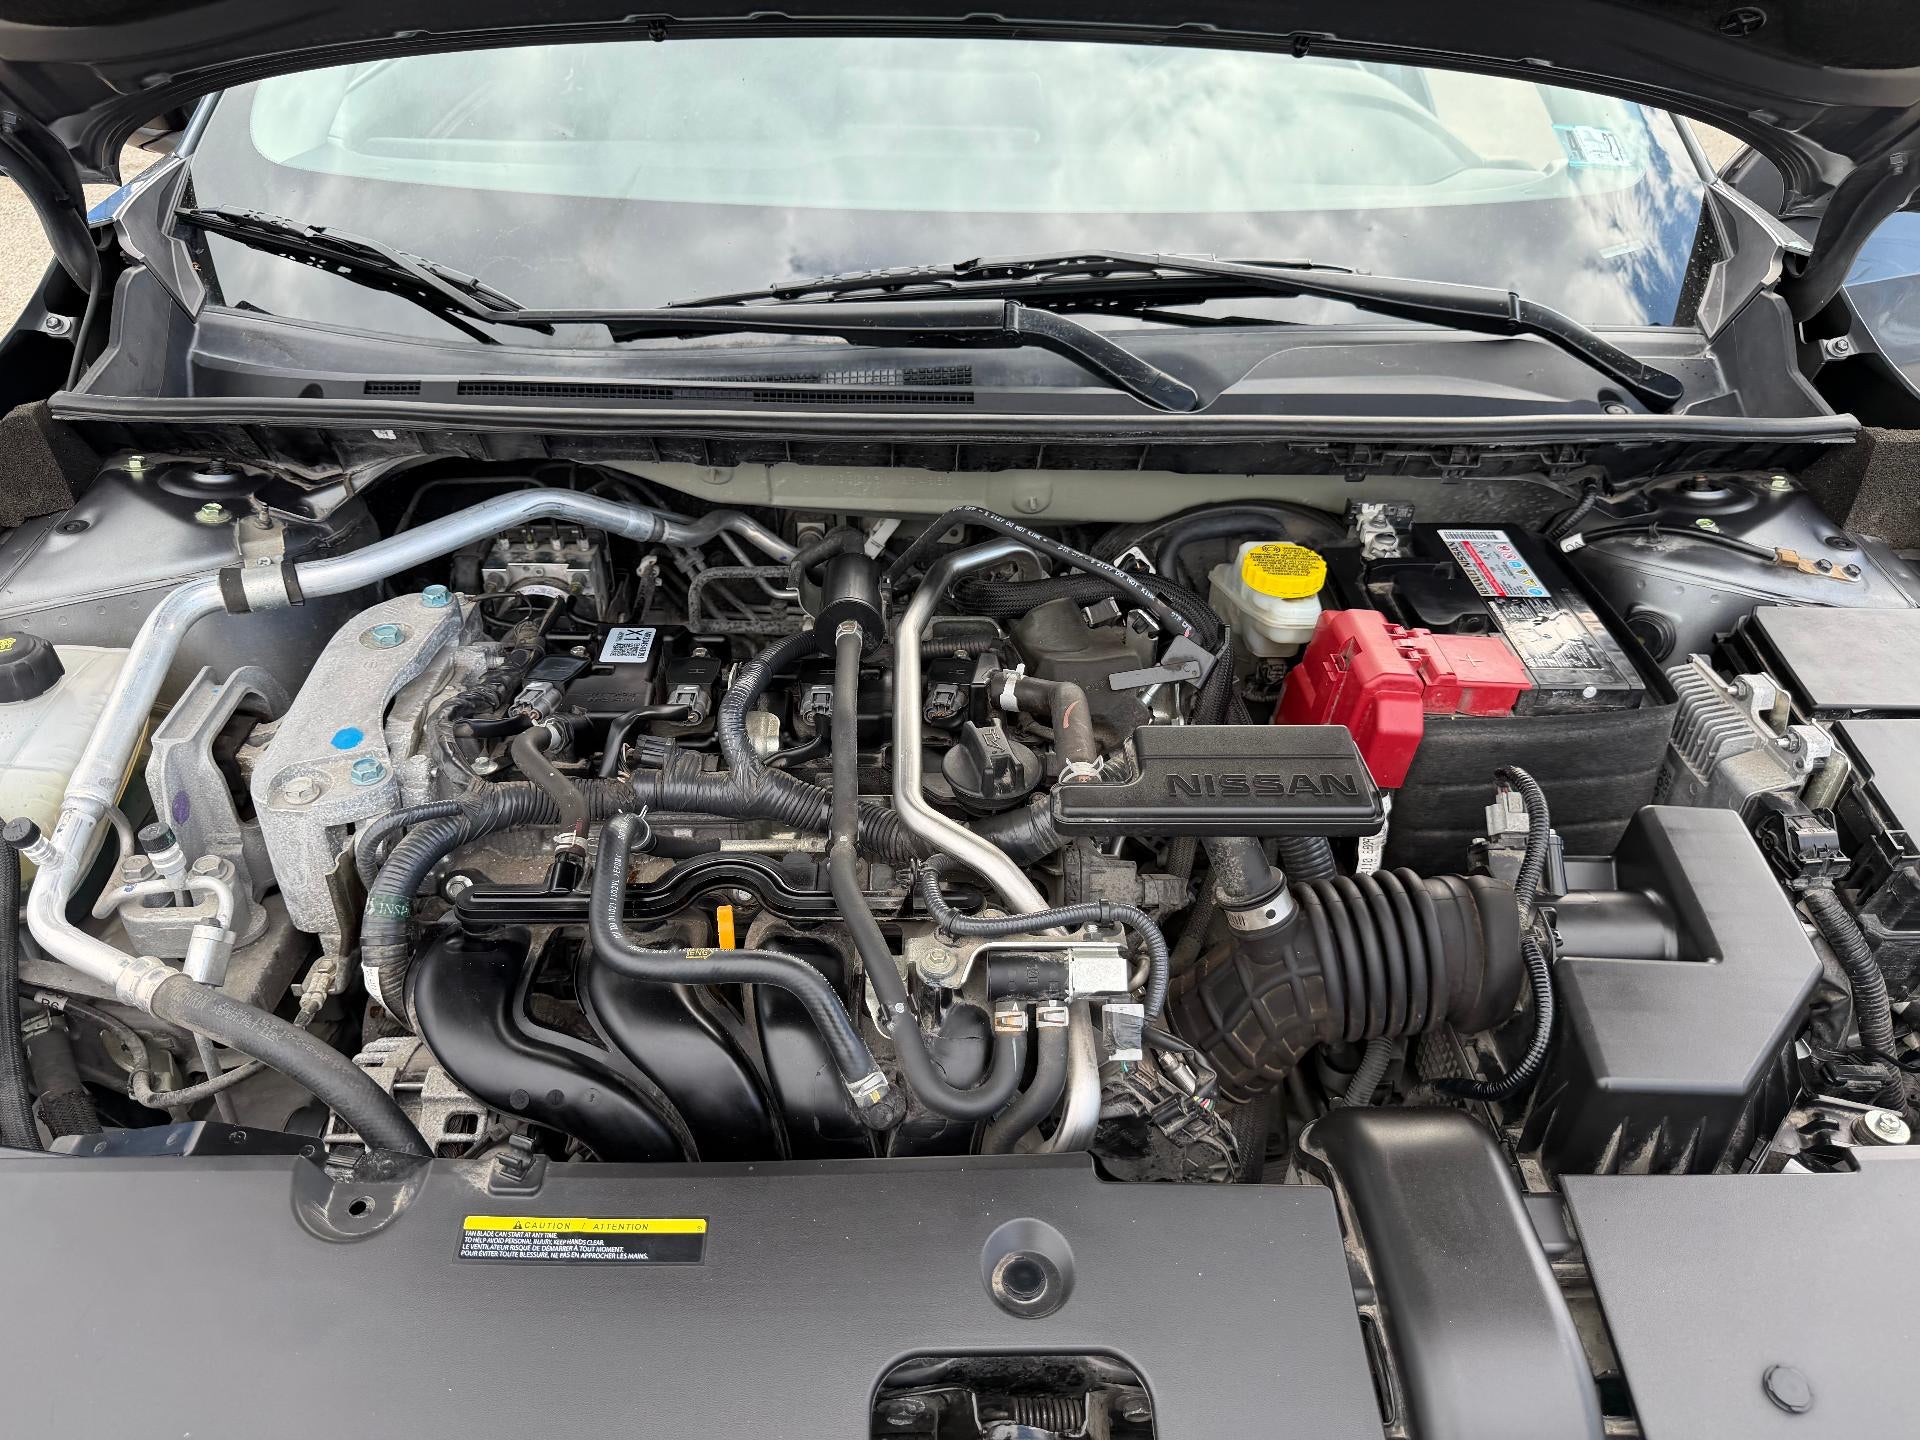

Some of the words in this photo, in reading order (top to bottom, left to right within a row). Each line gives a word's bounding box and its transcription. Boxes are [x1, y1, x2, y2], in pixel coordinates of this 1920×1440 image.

[1166, 773, 1359, 797] NISSAN
[524, 1221, 571, 1230] CAUTION
[593, 1223, 649, 1231] ATTENTION
[479, 1249, 499, 1257] ÉVITER
